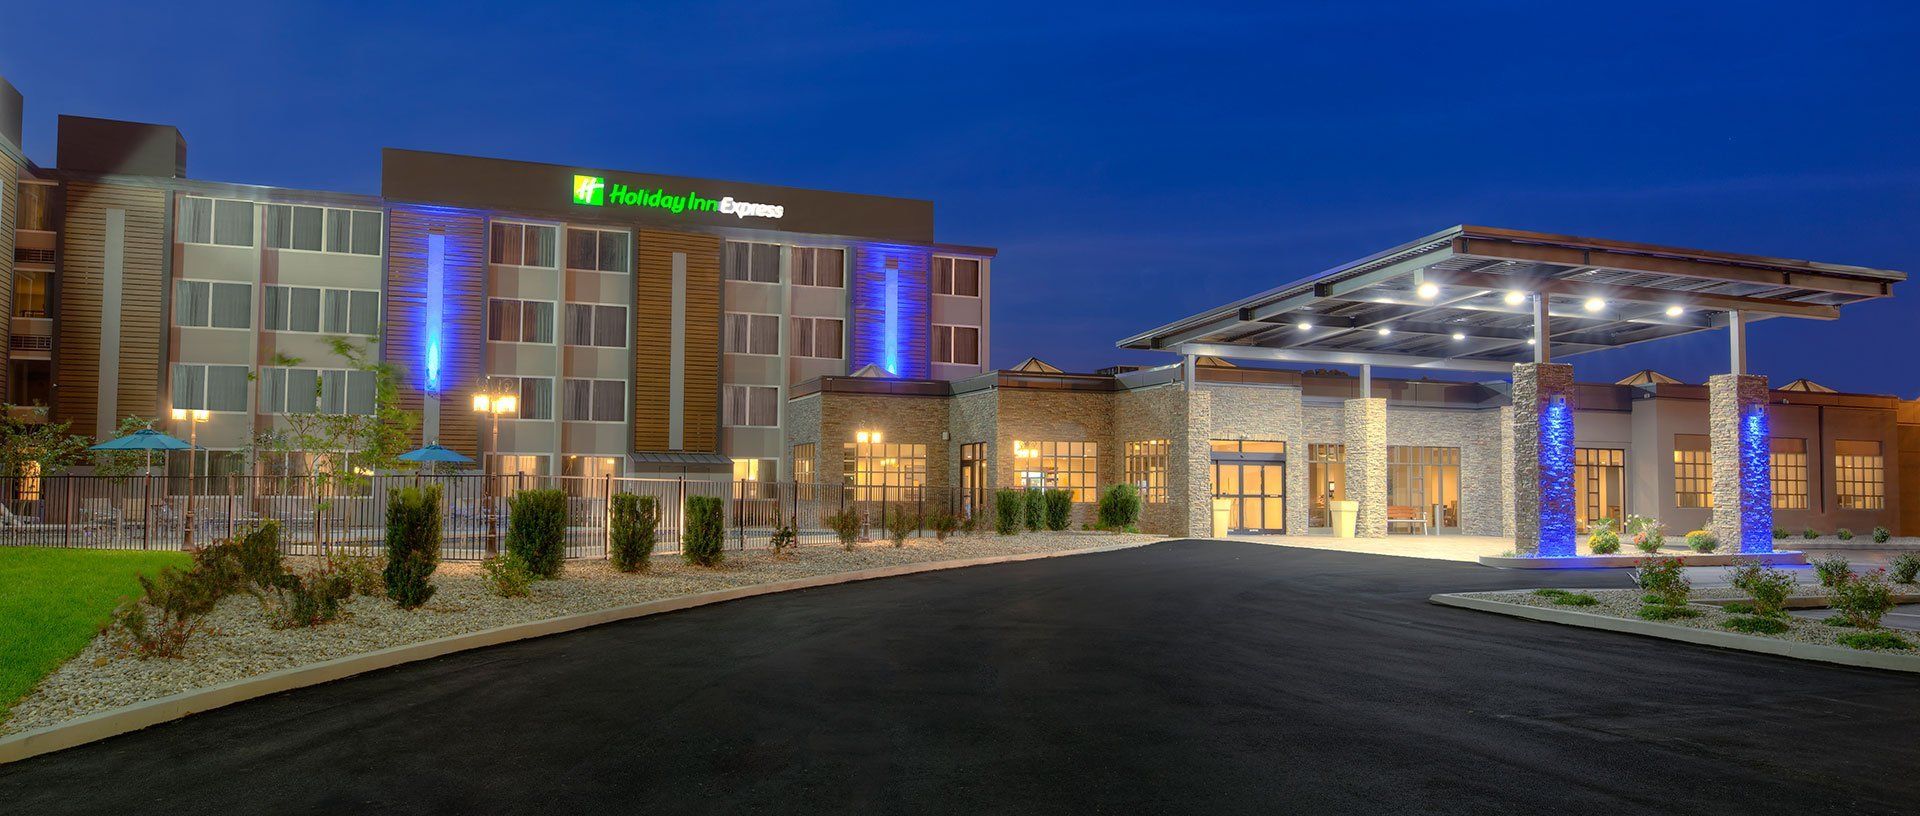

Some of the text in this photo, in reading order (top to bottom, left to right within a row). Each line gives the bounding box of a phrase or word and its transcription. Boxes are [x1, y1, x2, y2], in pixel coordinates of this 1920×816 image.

[609, 183, 685, 213] Holiday
[688, 192, 718, 212] Inn
[719, 197, 784, 218] Express
